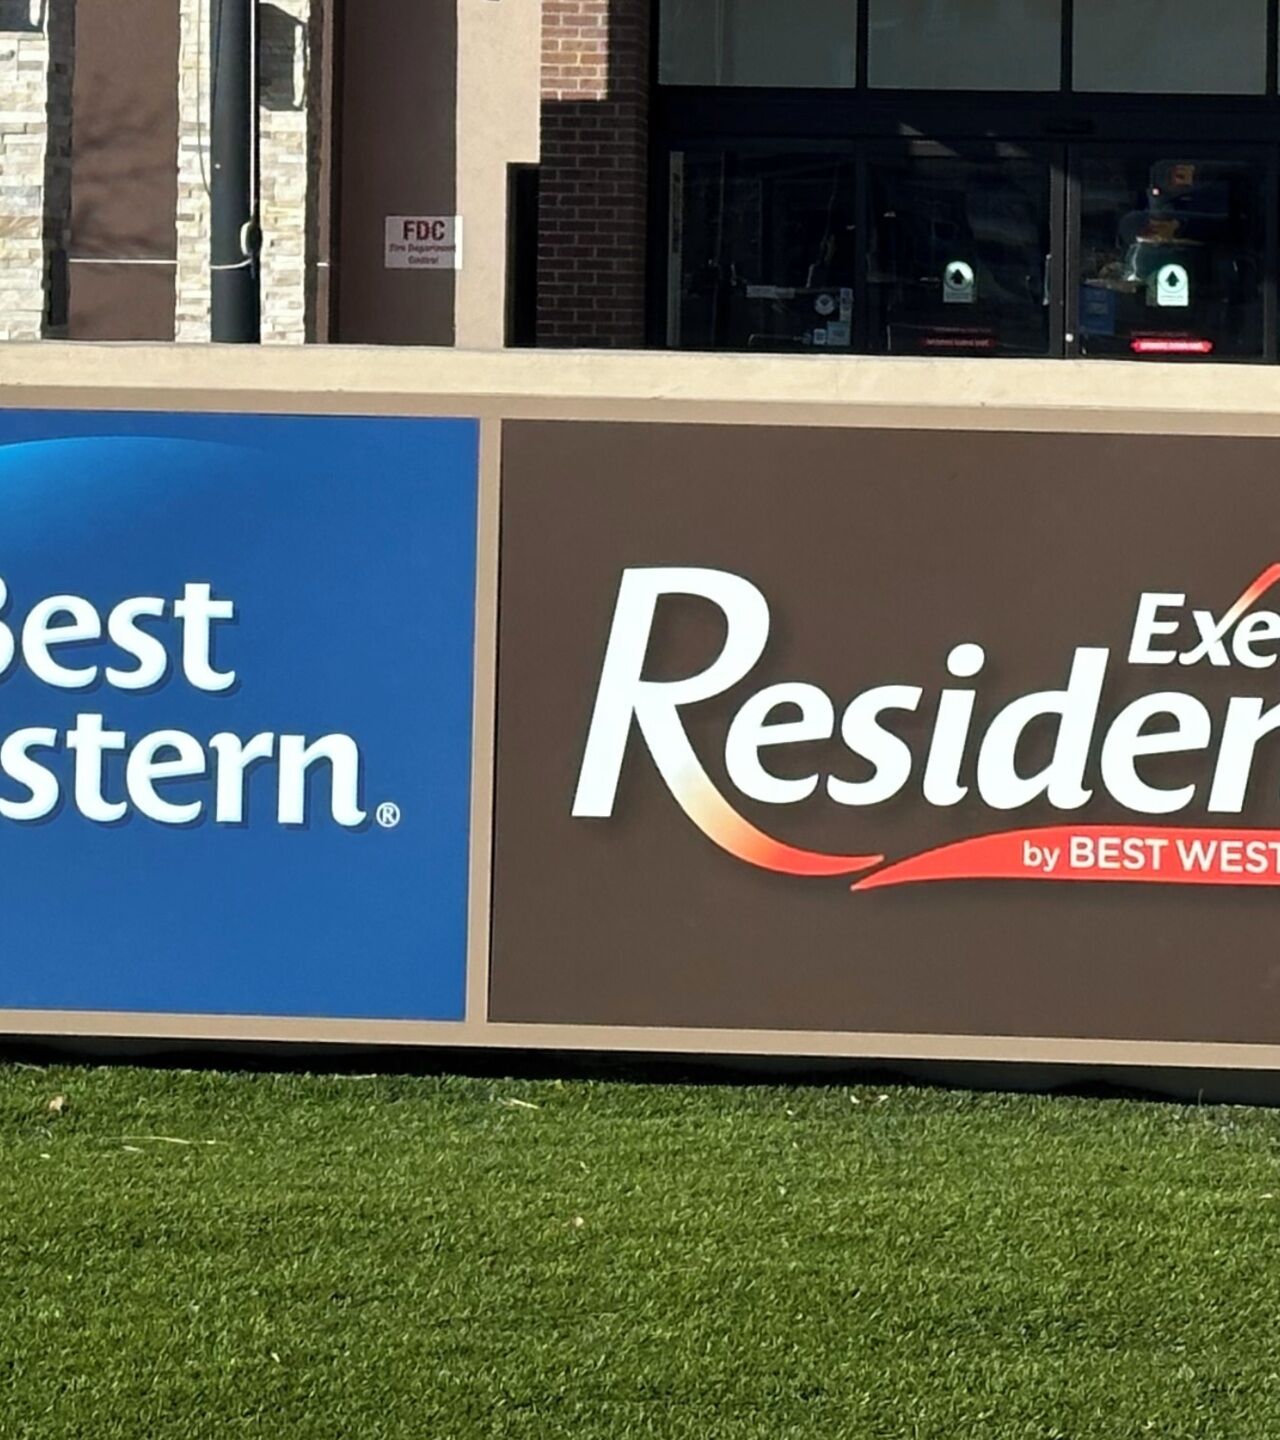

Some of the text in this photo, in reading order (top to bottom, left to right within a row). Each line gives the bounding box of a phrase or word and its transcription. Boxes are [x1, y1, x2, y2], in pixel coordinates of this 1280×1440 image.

[403, 220, 445, 241] FDC
[1023, 840, 1060, 872] by
[1070, 836, 1169, 871] BEST
